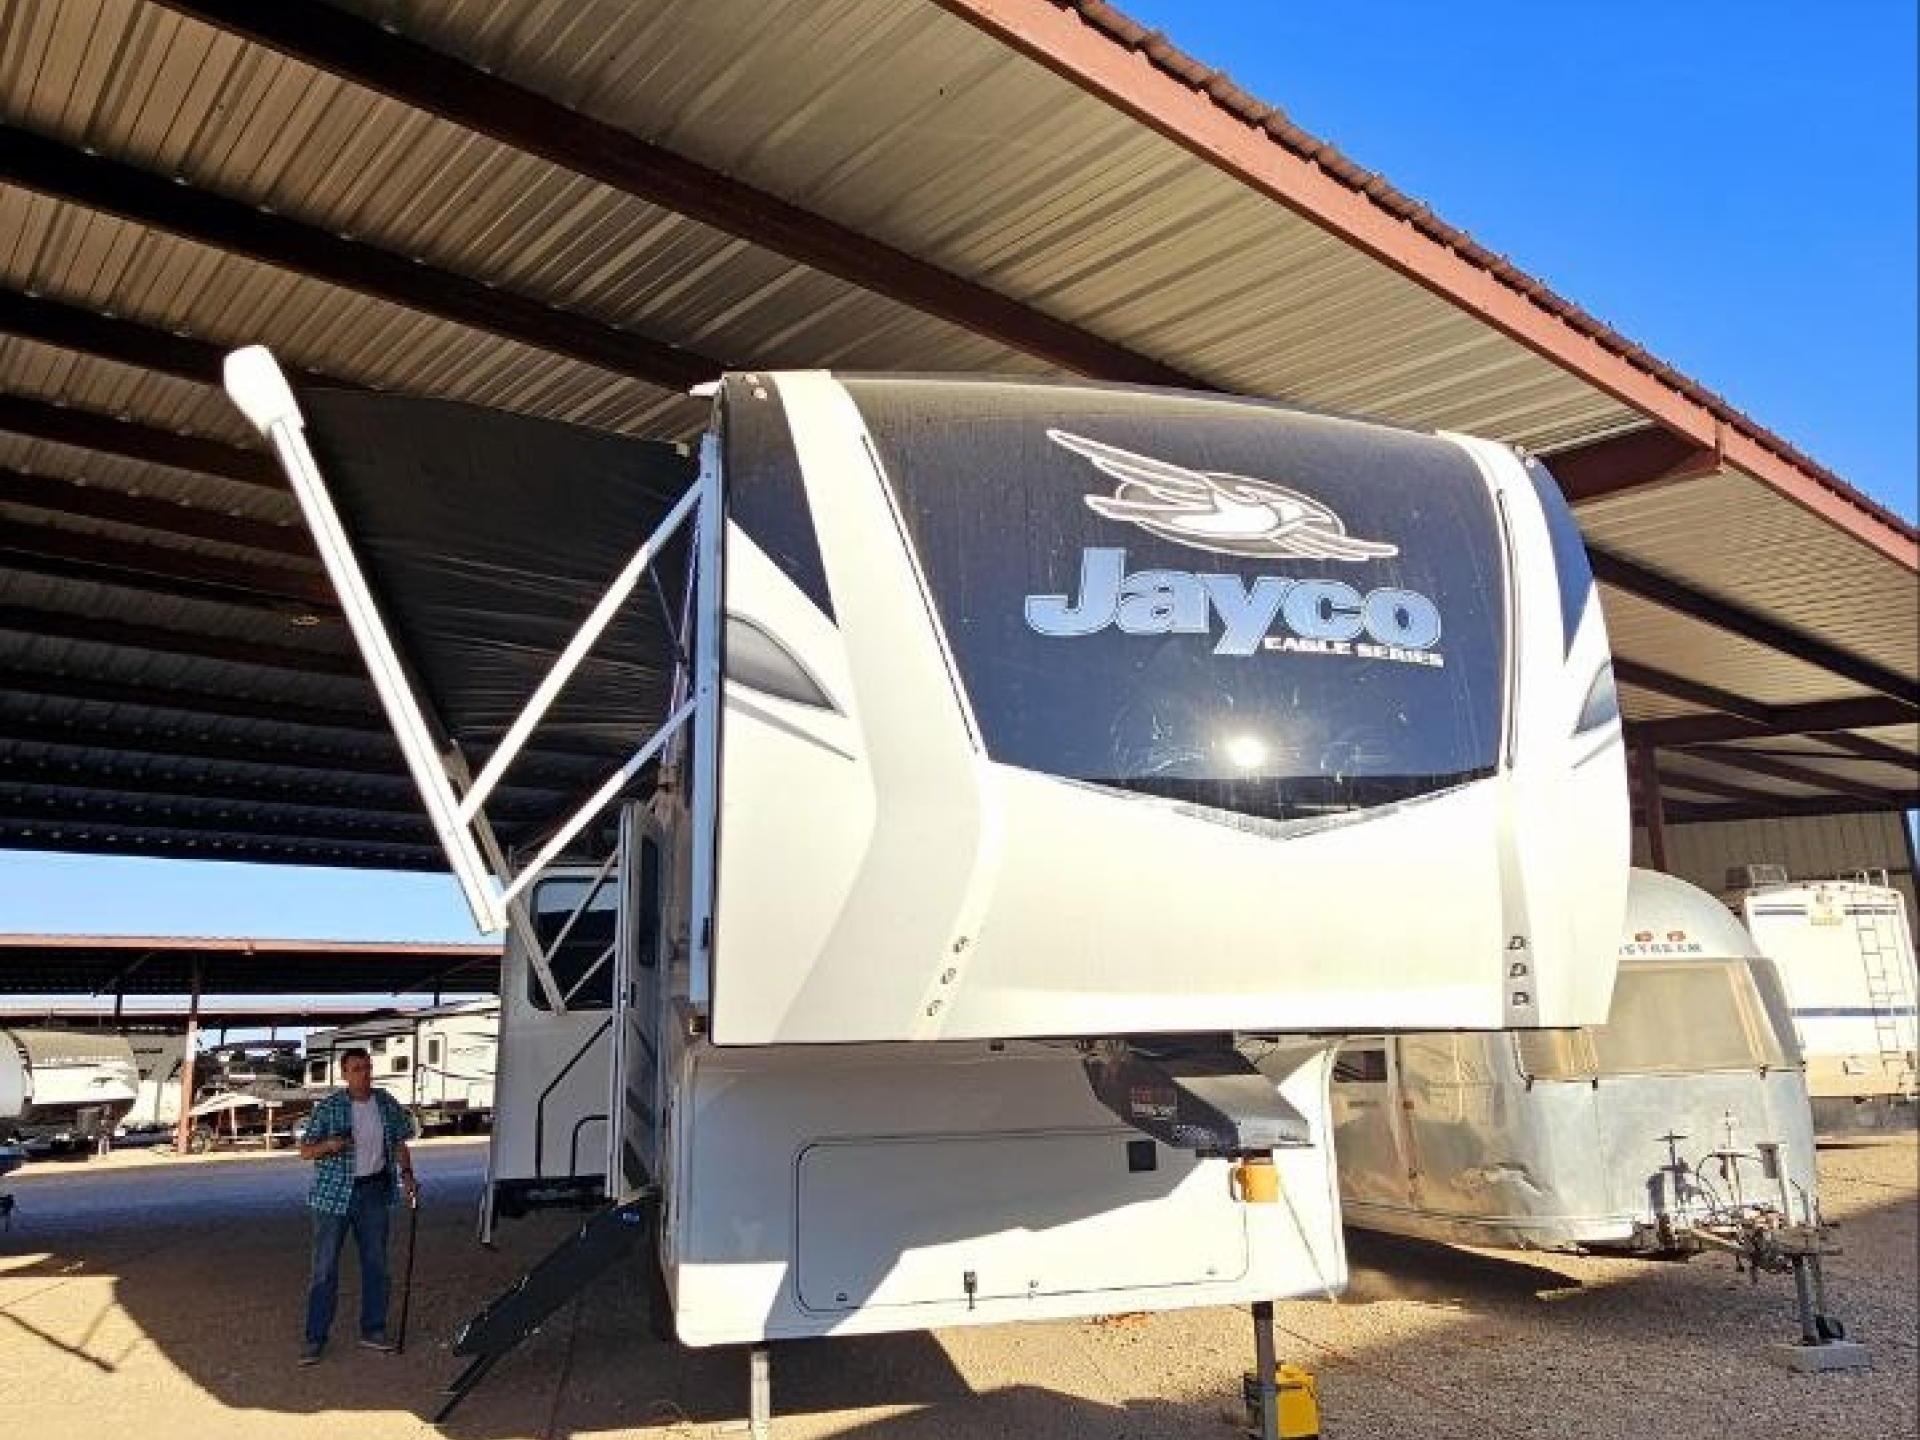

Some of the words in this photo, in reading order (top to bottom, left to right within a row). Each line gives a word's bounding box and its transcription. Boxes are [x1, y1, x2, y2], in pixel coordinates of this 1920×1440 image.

[1025, 547, 1441, 655] Jayco
[1264, 637, 1351, 655] EAGLE
[1357, 643, 1444, 668] SERIES
